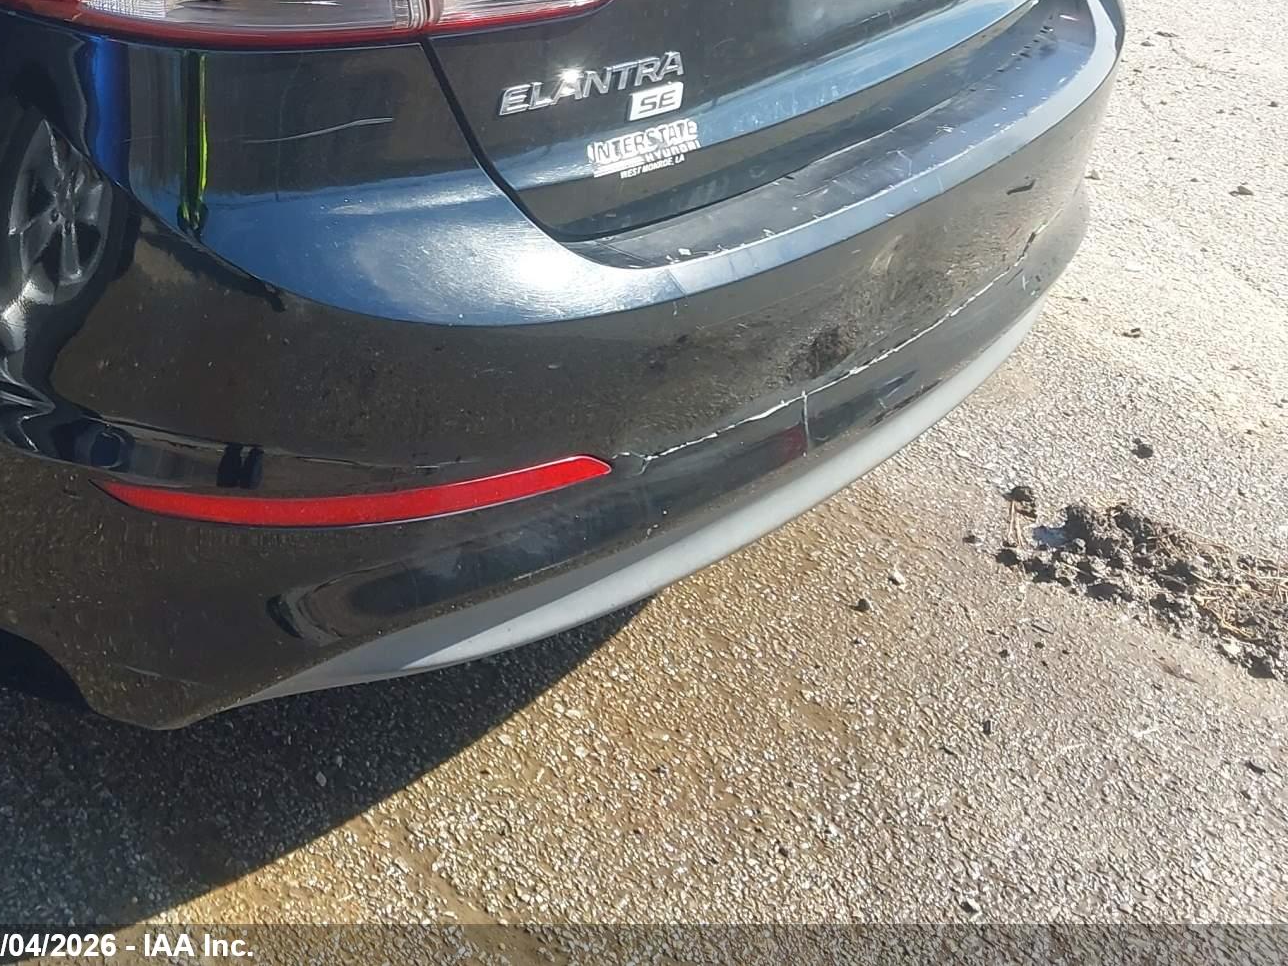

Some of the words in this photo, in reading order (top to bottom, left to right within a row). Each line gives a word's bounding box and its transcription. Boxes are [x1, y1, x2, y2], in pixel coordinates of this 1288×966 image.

[499, 51, 684, 115] ELANTRA
[637, 87, 677, 115] SE
[587, 119, 698, 164] INTERSTATE
[620, 166, 642, 179] WEST
[675, 153, 685, 164] LA
